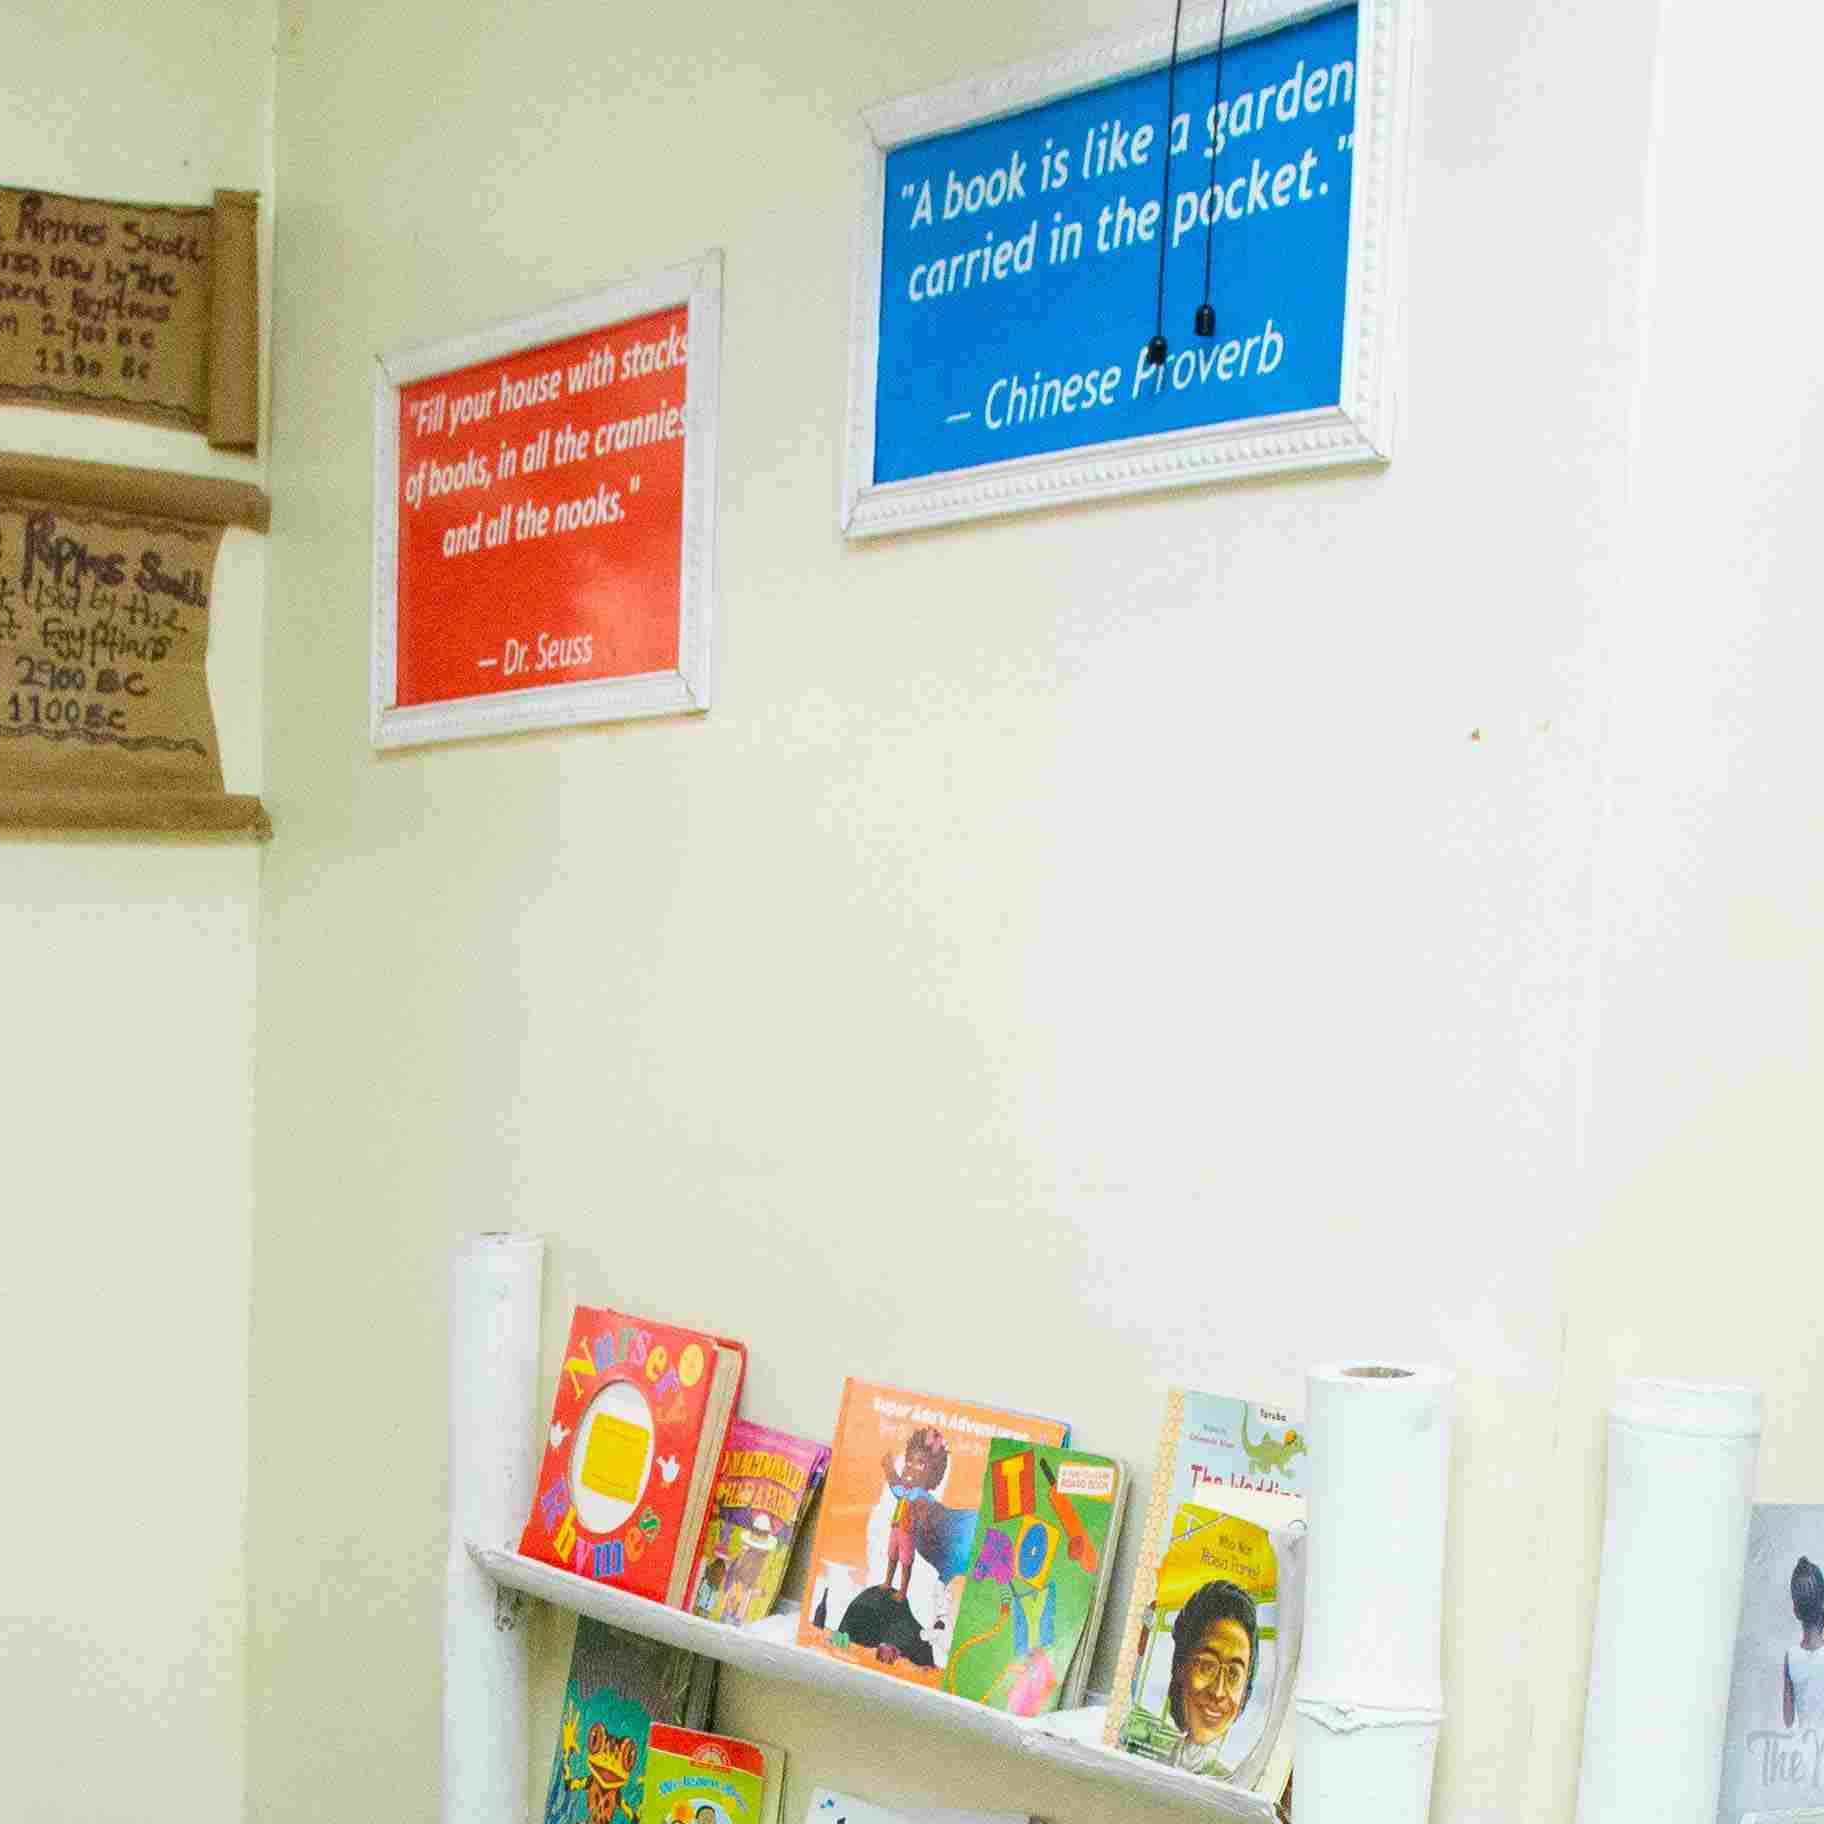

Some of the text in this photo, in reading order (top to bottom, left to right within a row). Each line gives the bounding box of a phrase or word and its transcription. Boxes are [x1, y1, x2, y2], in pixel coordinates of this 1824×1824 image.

[942, 154, 1027, 222] book
[1040, 139, 1069, 194] is
[1081, 119, 1153, 181] like
[1169, 110, 1191, 157] a
[1203, 58, 1356, 158] garden
[908, 220, 1036, 303] carried
[1048, 213, 1083, 265] in
[1096, 196, 1160, 254] the
[448, 390, 496, 438] your
[499, 371, 560, 413] house
[567, 343, 615, 394] with
[620, 325, 689, 378] stacks
[984, 365, 1121, 431] Chinese
[405, 400, 689, 510] of books, in all the crannies
[442, 516, 480, 558] and
[485, 504, 511, 547] all
[515, 500, 548, 540] the
[503, 632, 593, 675] Dr. Seuss
[8, 695, 81, 724] 1100
